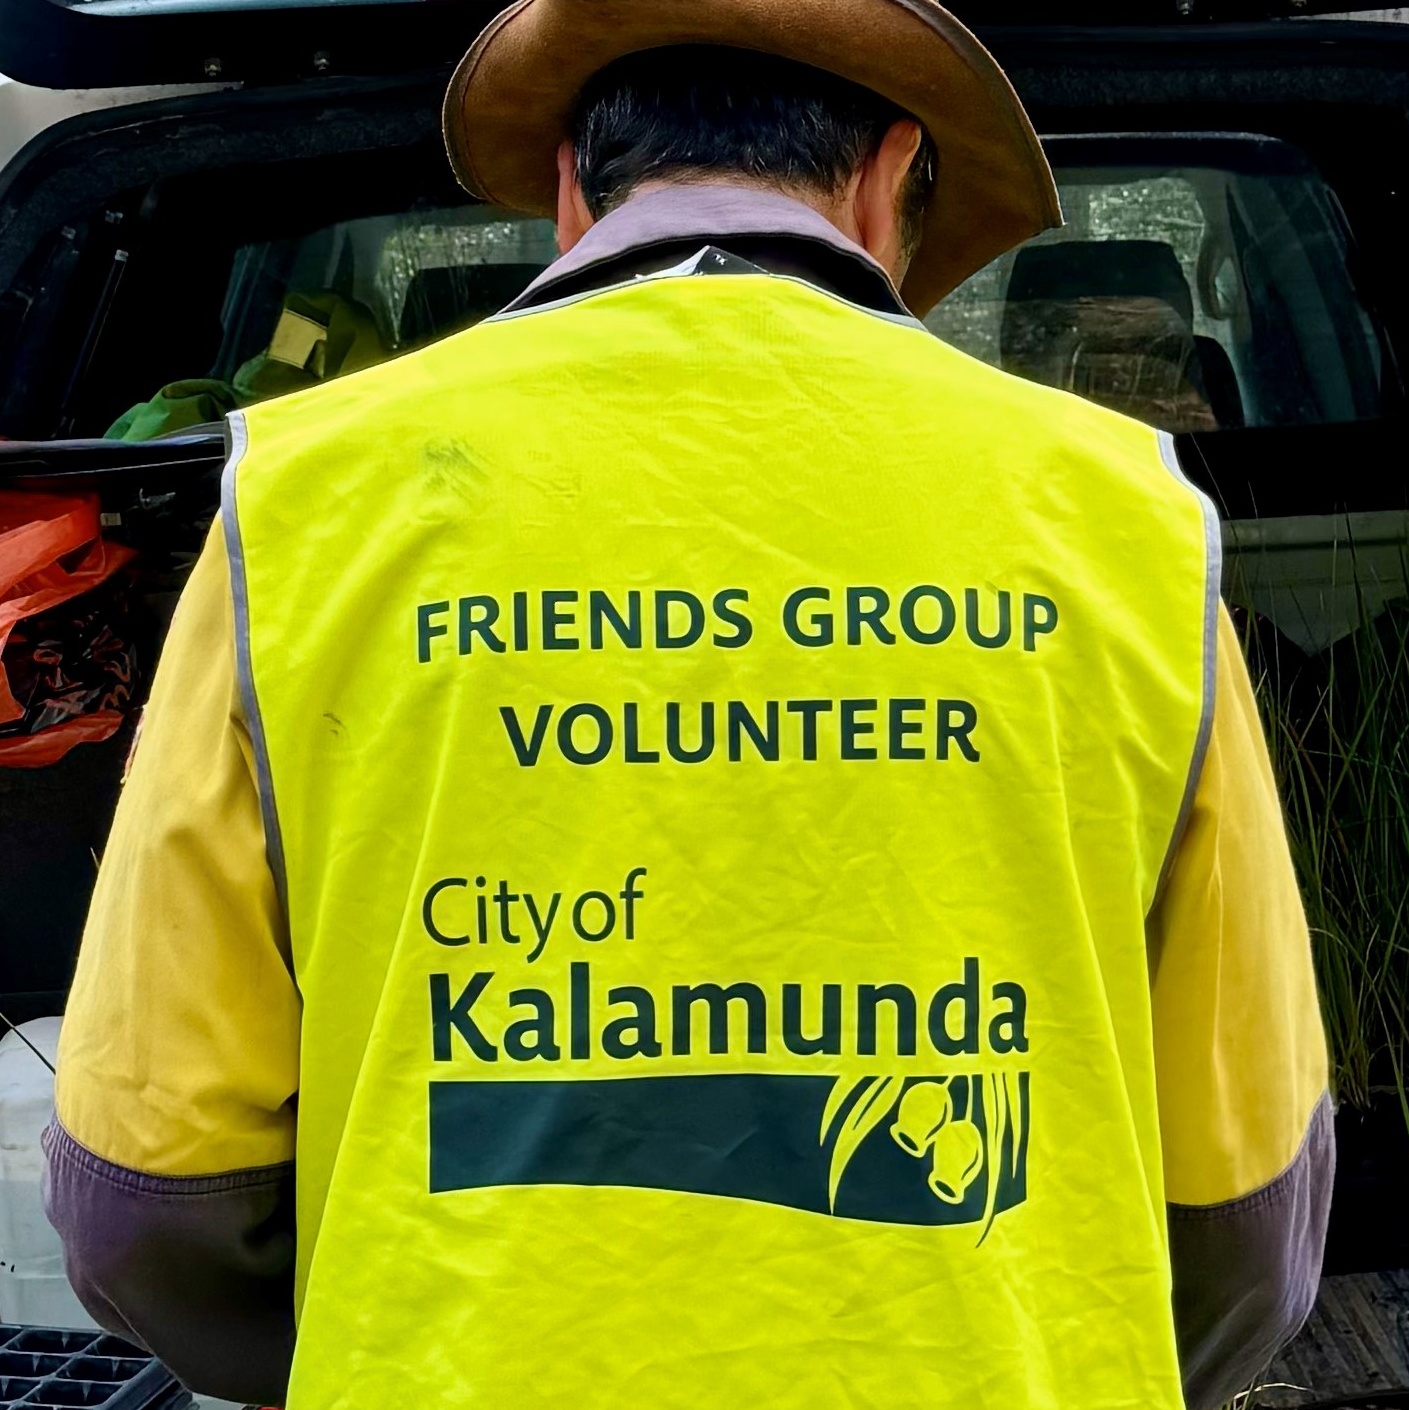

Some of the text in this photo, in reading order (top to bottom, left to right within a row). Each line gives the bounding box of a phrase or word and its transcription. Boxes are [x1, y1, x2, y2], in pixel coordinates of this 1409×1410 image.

[417, 585, 1059, 663] FRIENDS GROUP
[499, 698, 980, 767] VOLUNTEER
[422, 867, 647, 962] City of
[428, 956, 1029, 1062] Kalamunda
